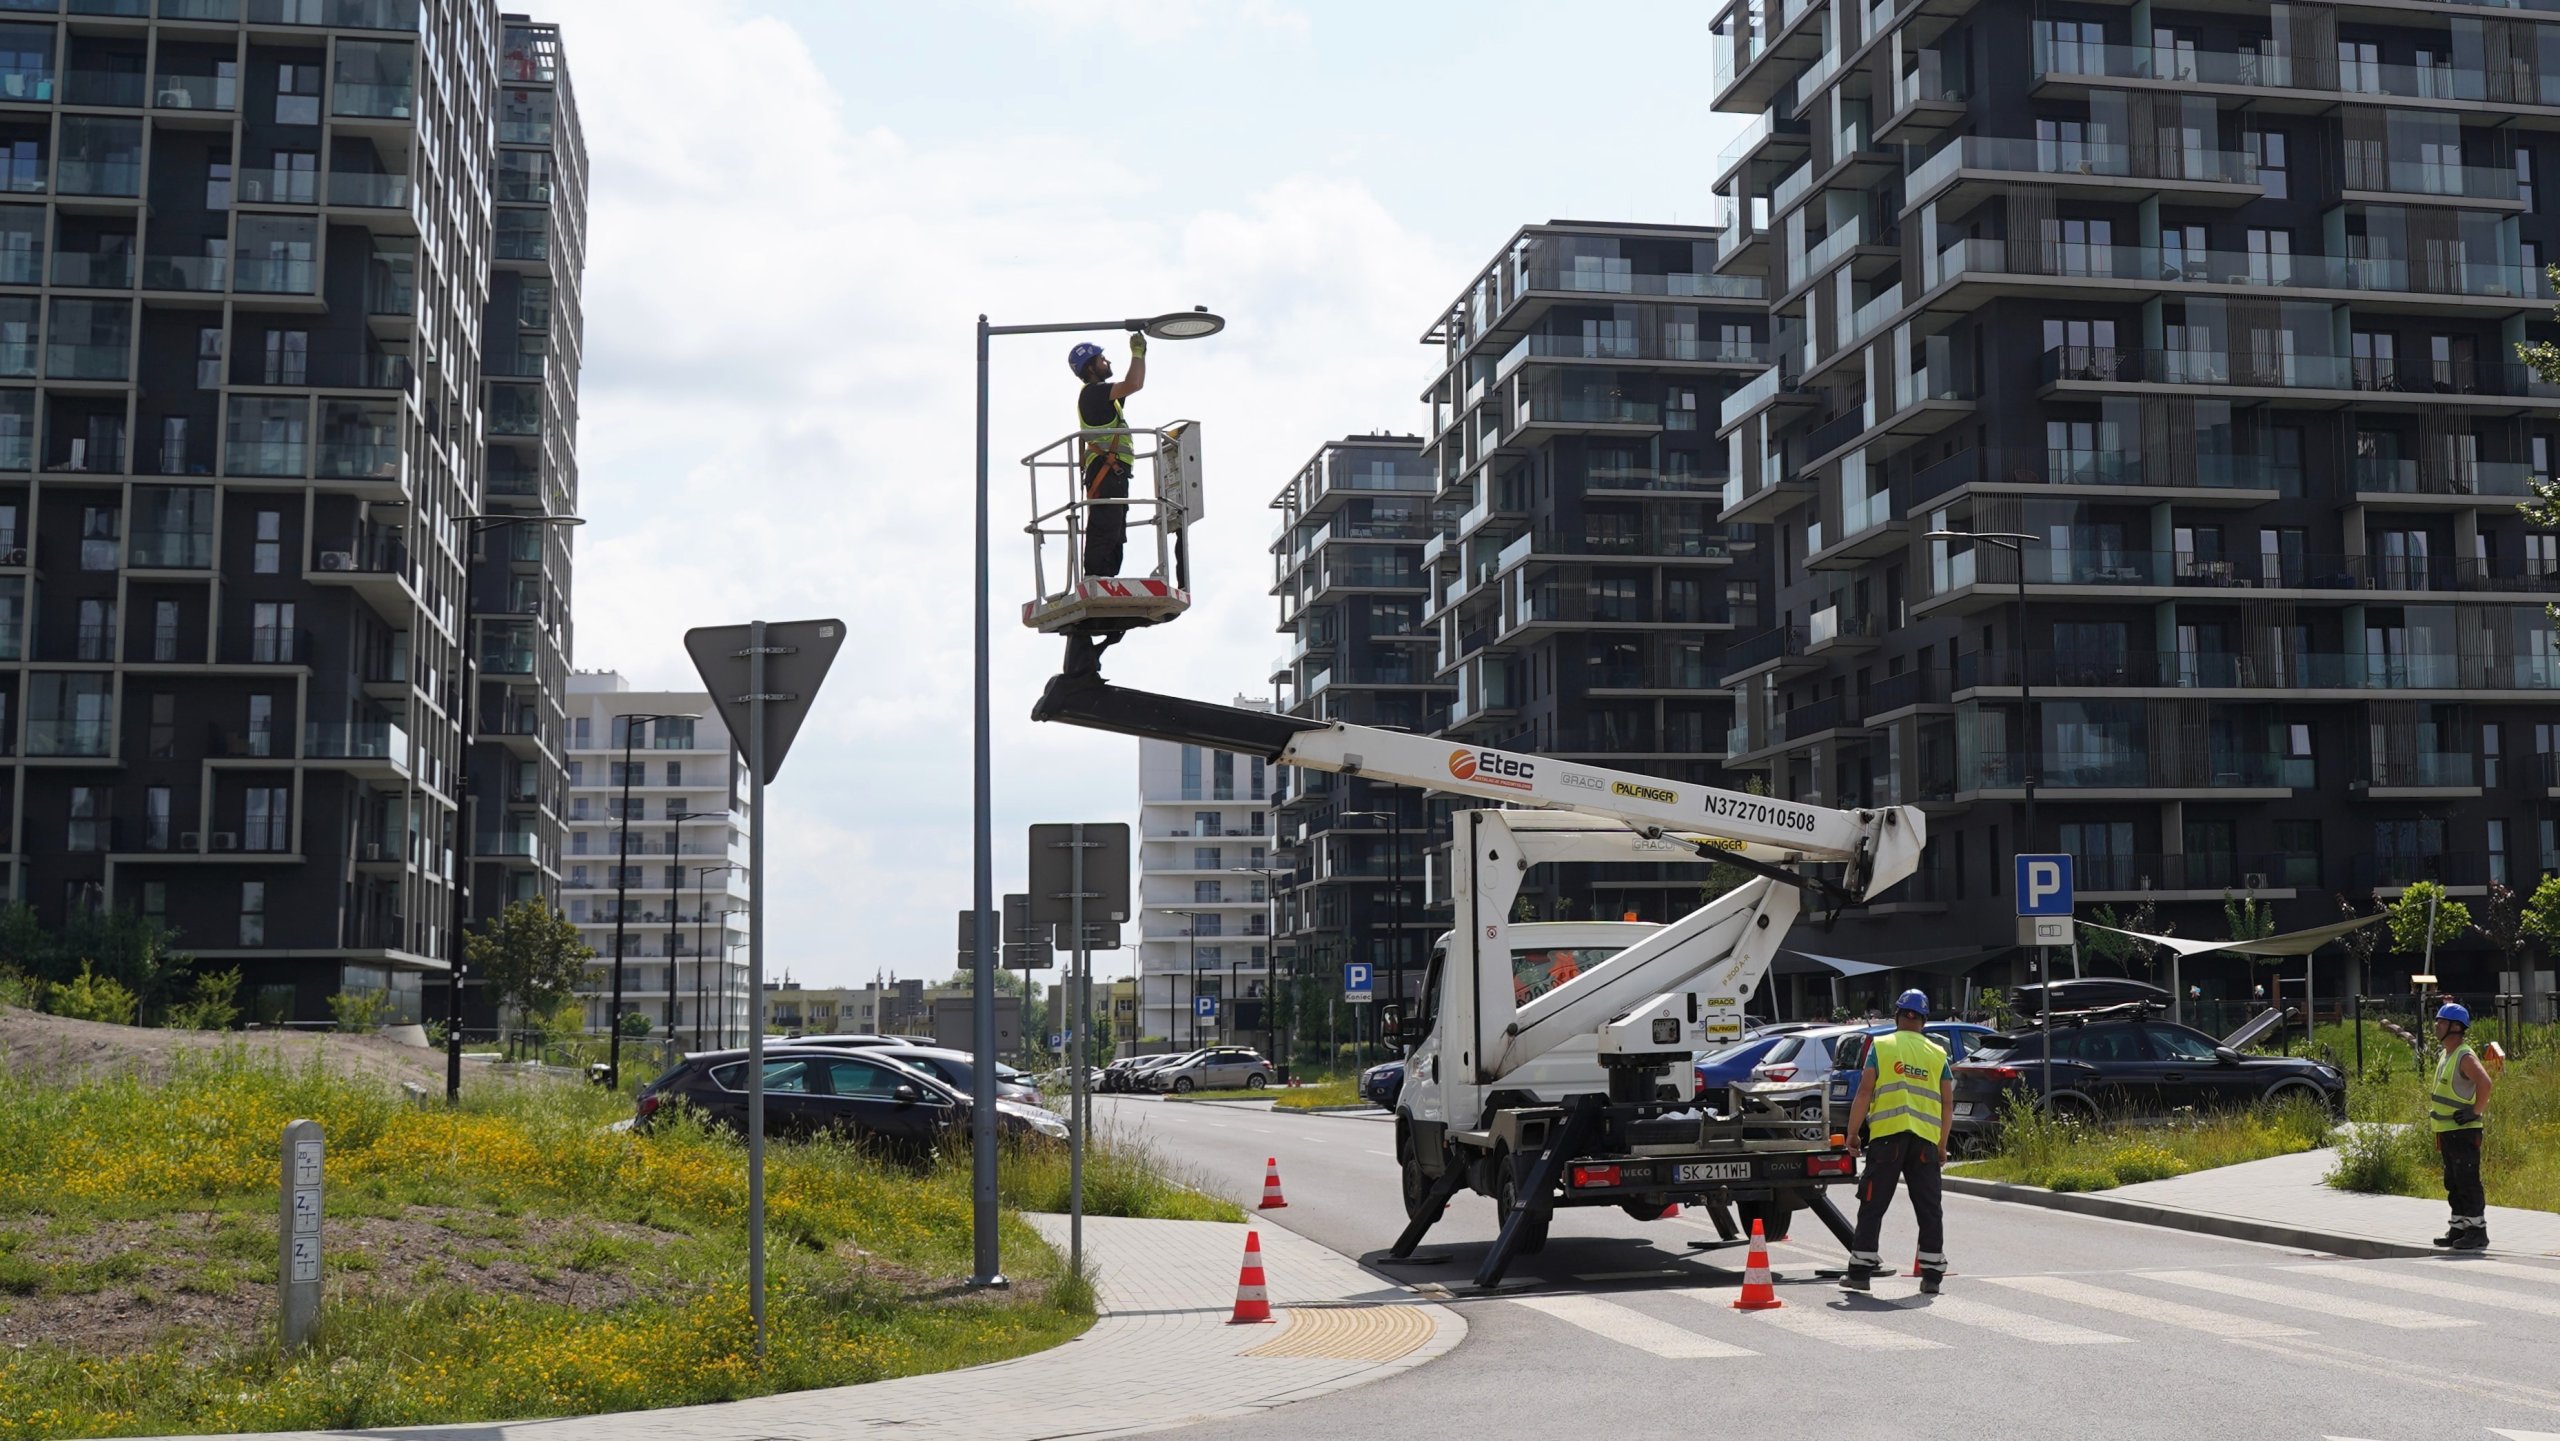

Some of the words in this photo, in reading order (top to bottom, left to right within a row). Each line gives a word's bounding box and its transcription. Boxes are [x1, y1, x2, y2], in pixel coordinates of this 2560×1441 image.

[1479, 751, 1534, 779] Etec
[1562, 773, 1604, 789] GRACO
[1616, 783, 1674, 802] PALFINGER
[1705, 795, 1815, 832] N3727010508
[2028, 861, 2060, 908] P
[1351, 966, 1367, 988] P
[1199, 998, 1211, 1014] P
[1052, 1035, 1060, 1046] P
[1904, 1064, 1928, 1077] Etec
[1620, 1167, 1652, 1177] IVECO
[1682, 1165, 1700, 1180] SK
[1705, 1163, 1748, 1179] 211WH
[1771, 1162, 1802, 1170] DAILY
